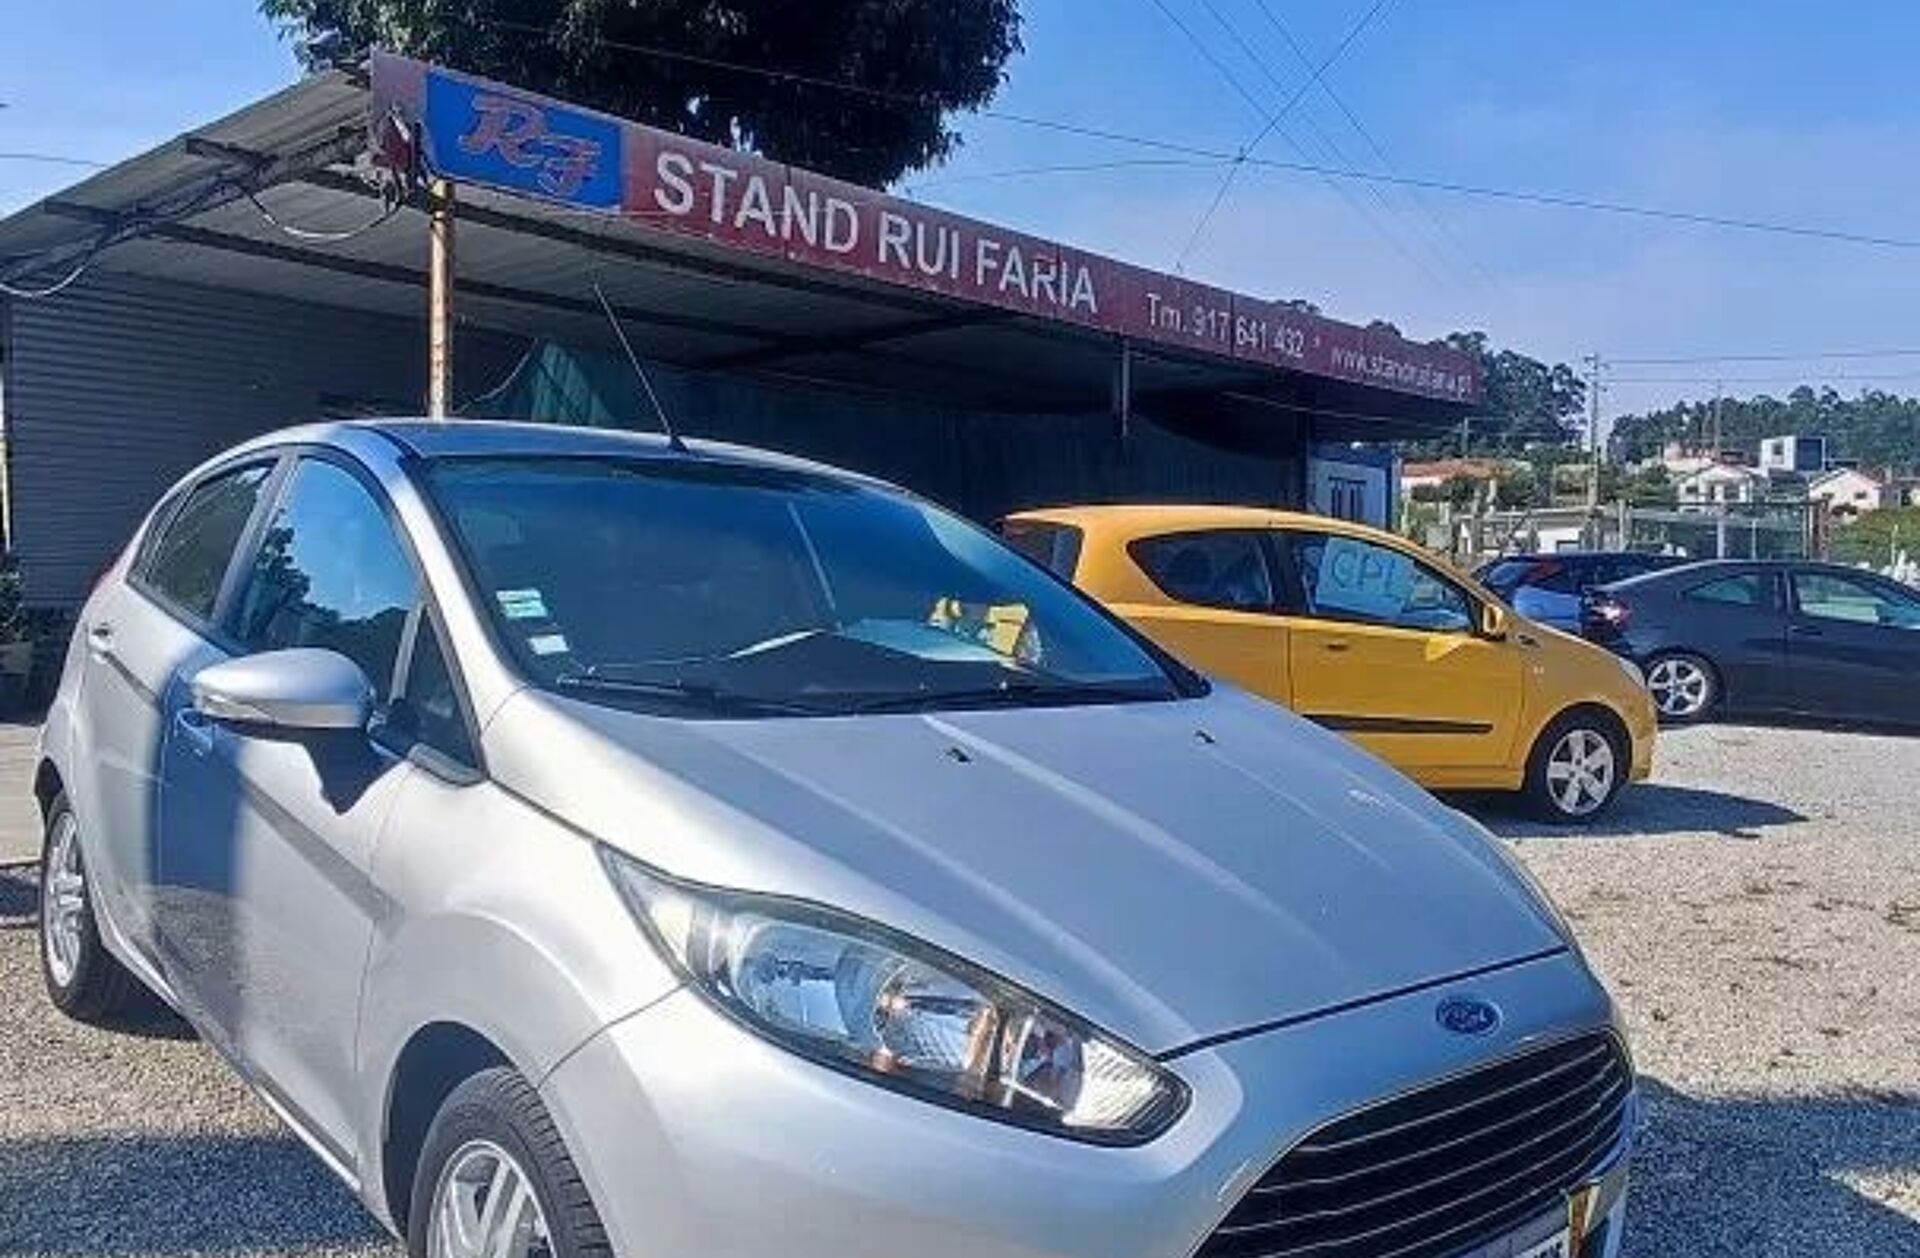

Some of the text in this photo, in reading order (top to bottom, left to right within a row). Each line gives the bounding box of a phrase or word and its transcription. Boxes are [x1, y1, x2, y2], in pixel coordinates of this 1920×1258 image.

[654, 152, 1098, 314] STAND RUI FARIA
[1193, 306, 1230, 342] 917
[1236, 316, 1267, 350] 641
